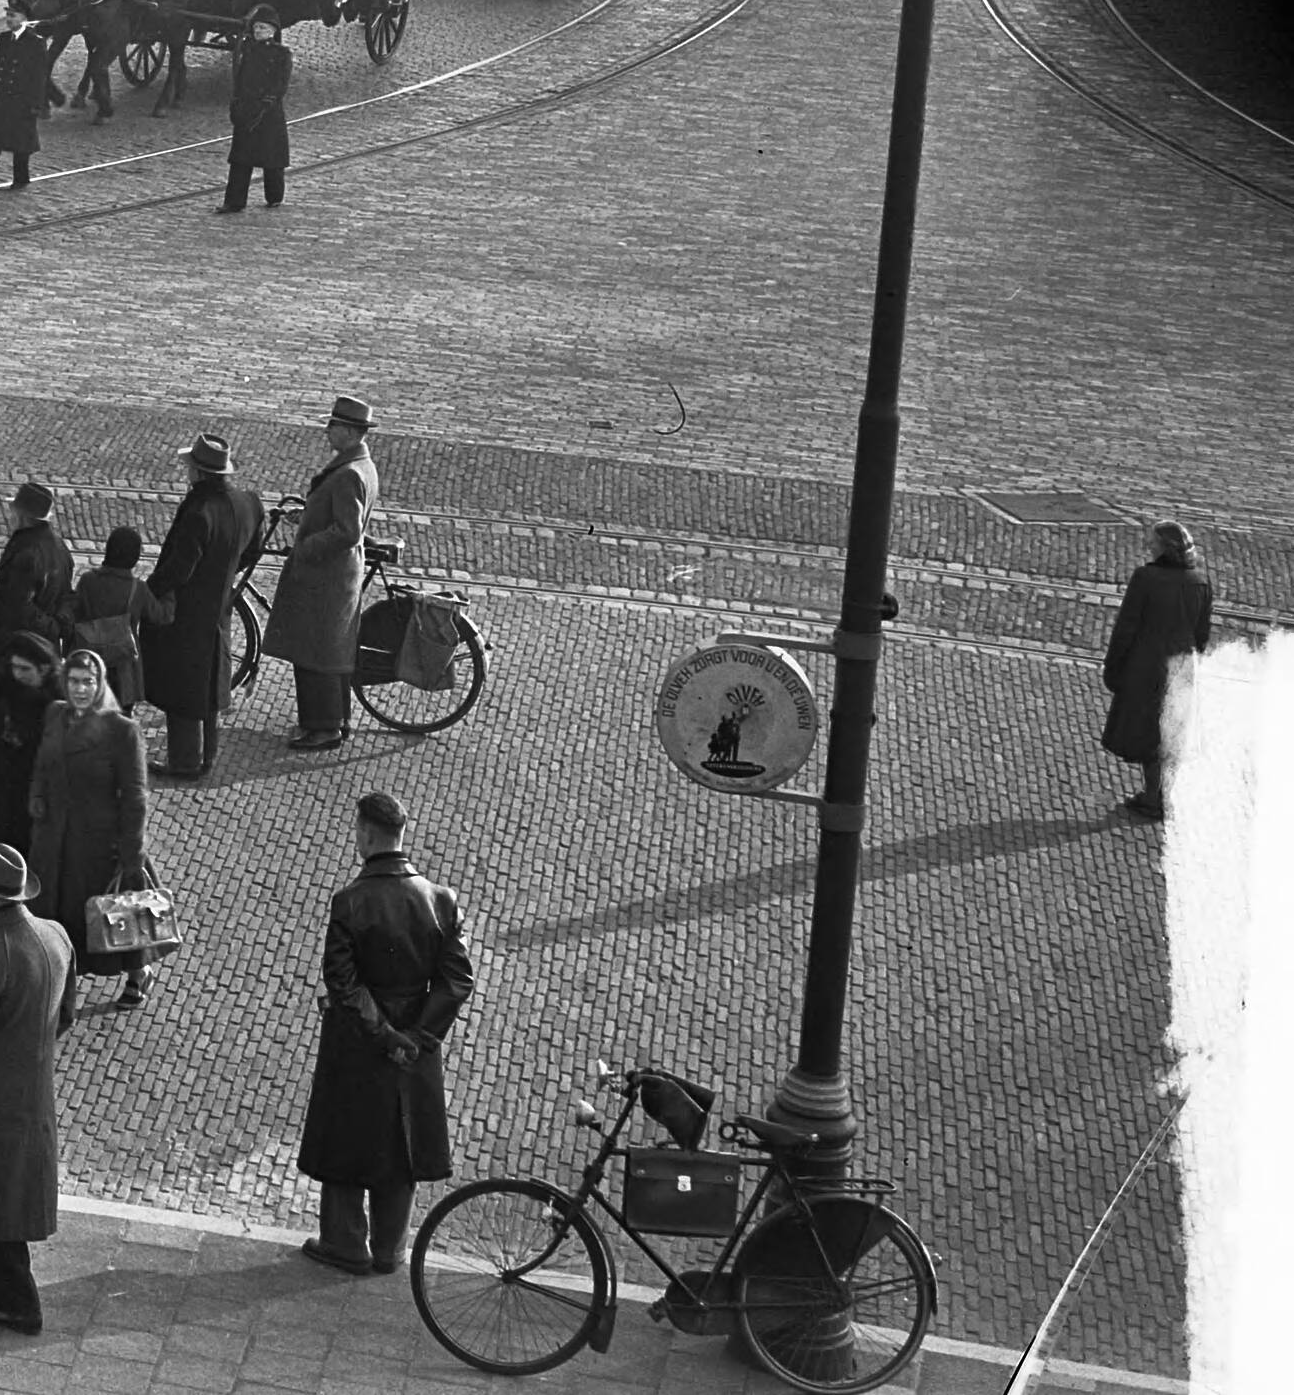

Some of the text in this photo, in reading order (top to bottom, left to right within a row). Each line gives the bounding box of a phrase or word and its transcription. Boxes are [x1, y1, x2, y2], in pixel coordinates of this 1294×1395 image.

[662, 649, 812, 731] DE OLVEH ZORGT VOOR U EN DE UWEN
